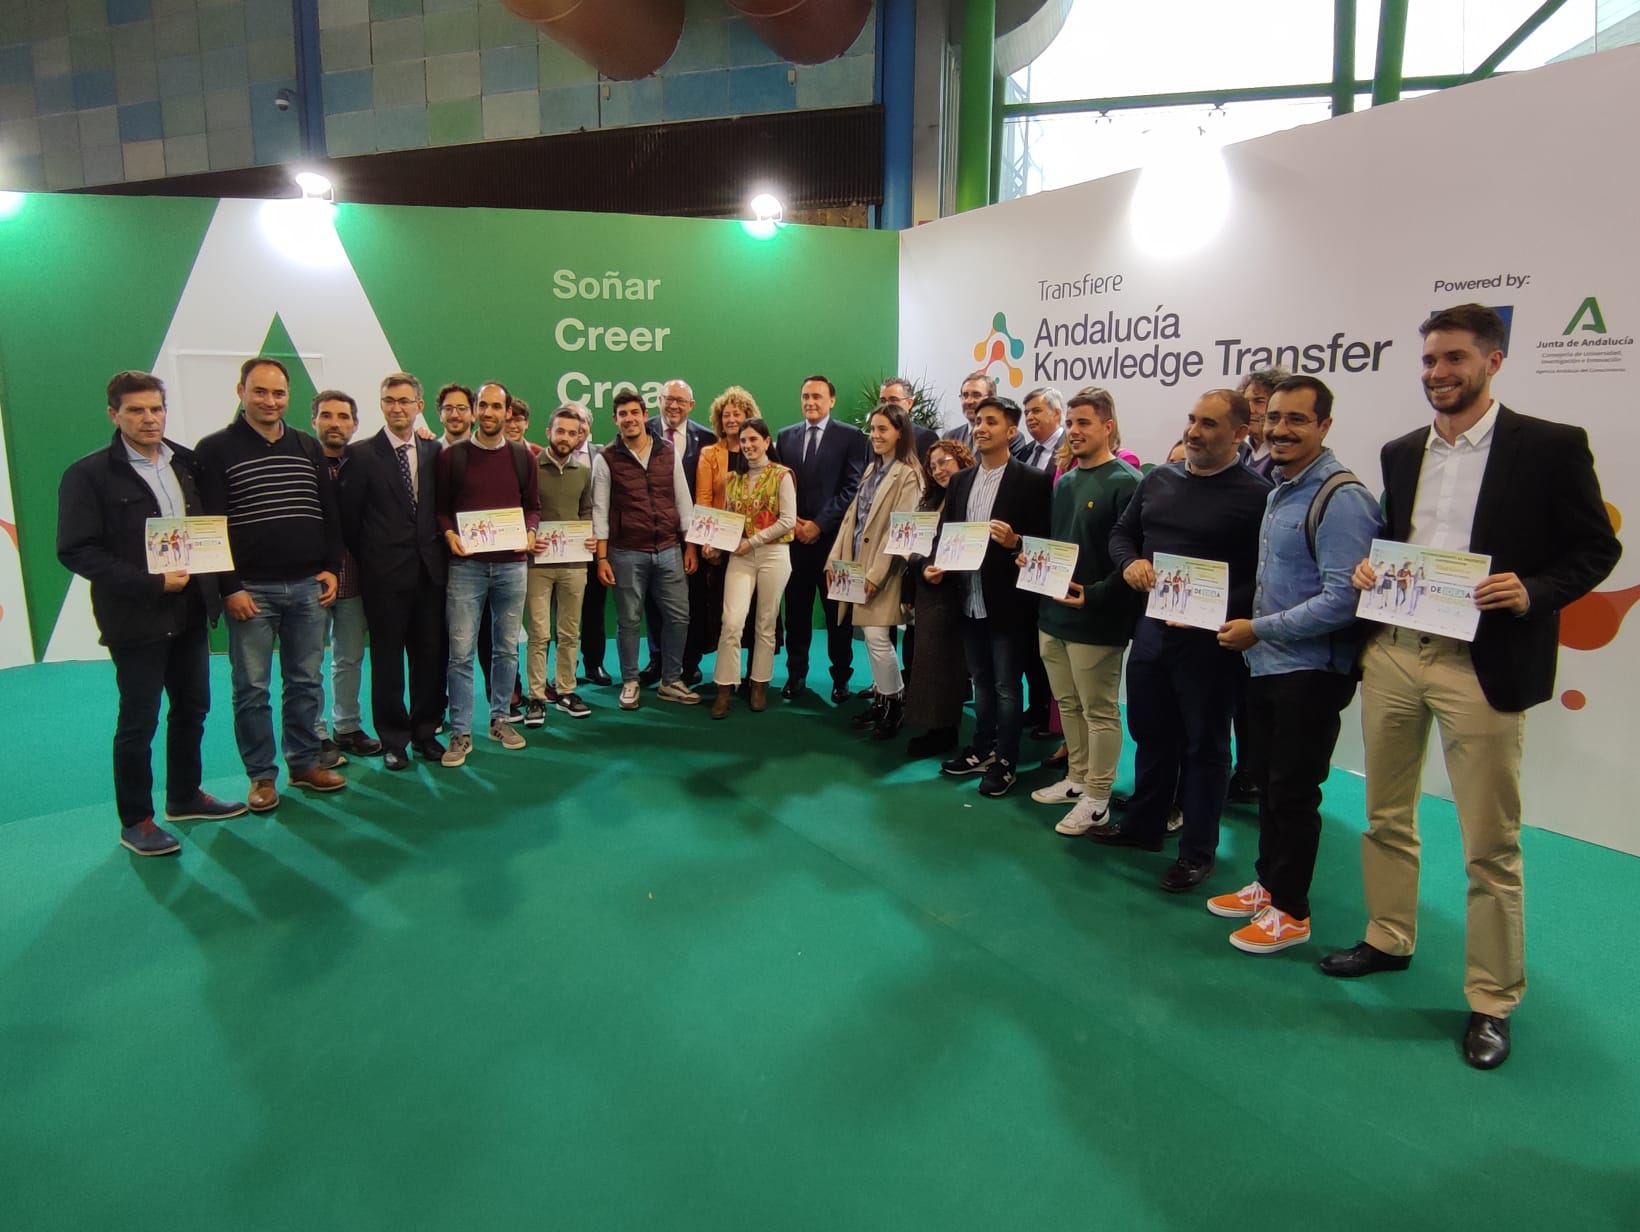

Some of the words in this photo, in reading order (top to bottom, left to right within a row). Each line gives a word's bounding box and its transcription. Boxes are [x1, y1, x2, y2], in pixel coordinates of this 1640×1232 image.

[552, 269, 661, 300] Soñar
[1038, 272, 1123, 301] Transfiere
[1434, 275, 1502, 292] Powered
[1506, 273, 1531, 288] by:
[554, 317, 671, 352] Creer
[1033, 304, 1181, 348] Andalucía
[1536, 340, 1564, 348] Junta
[1566, 339, 1579, 347] de
[1581, 336, 1634, 347] Andalucía
[1033, 344, 1204, 387] Knowledge
[1215, 332, 1393, 376] Transfer
